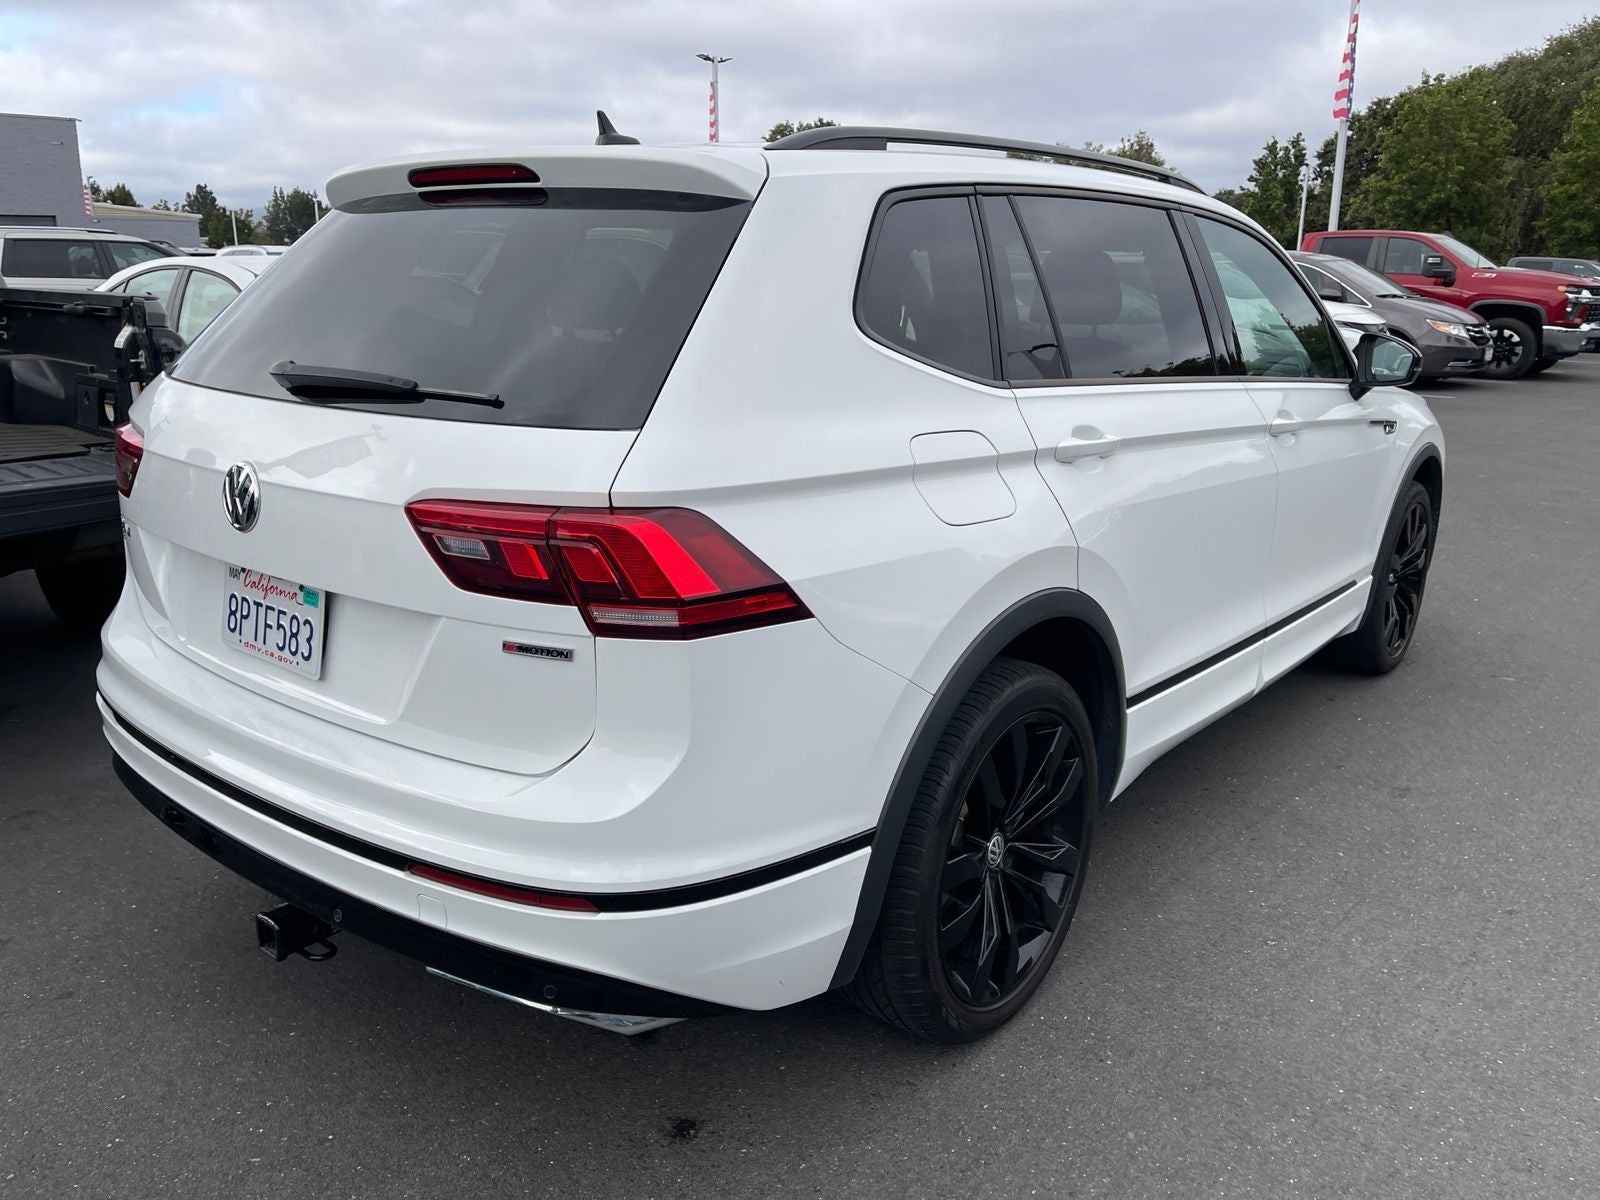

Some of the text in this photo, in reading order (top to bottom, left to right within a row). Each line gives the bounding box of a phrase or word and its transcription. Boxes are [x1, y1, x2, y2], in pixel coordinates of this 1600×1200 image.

[243, 569, 304, 606] California
[227, 592, 314, 662] 8PTF583
[243, 641, 294, 665] dmv.ca.gov
